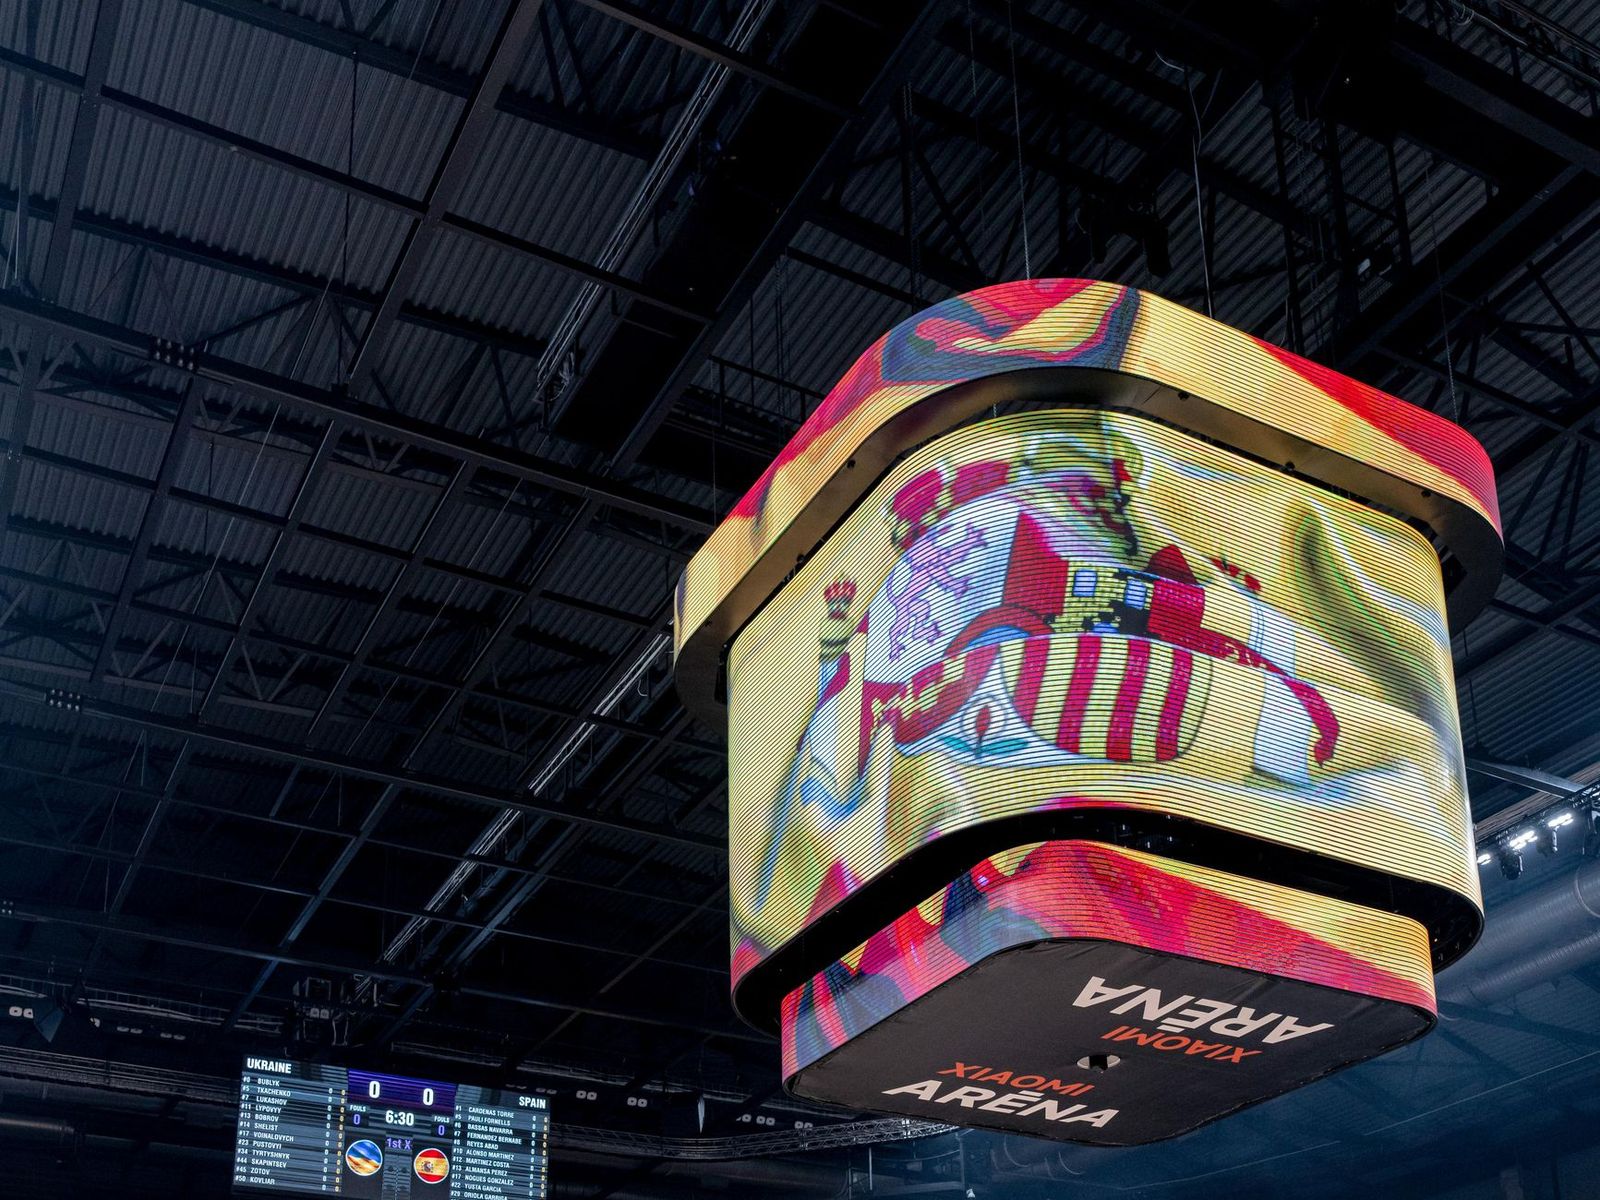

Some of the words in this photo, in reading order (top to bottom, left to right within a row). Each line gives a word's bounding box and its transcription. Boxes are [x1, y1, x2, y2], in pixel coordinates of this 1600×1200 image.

[1101, 1026, 1263, 1063] XIAOMI
[247, 1058, 291, 1073] UKRAINE
[938, 1062, 1095, 1097] XIAOMI
[369, 1081, 380, 1098] 0
[423, 1088, 433, 1105] 0
[519, 1096, 545, 1109] SPAIN
[354, 1114, 360, 1124] 0
[386, 1110, 414, 1126] 6:30
[438, 1125, 444, 1136] 0
[387, 1138, 401, 1148] 1st
